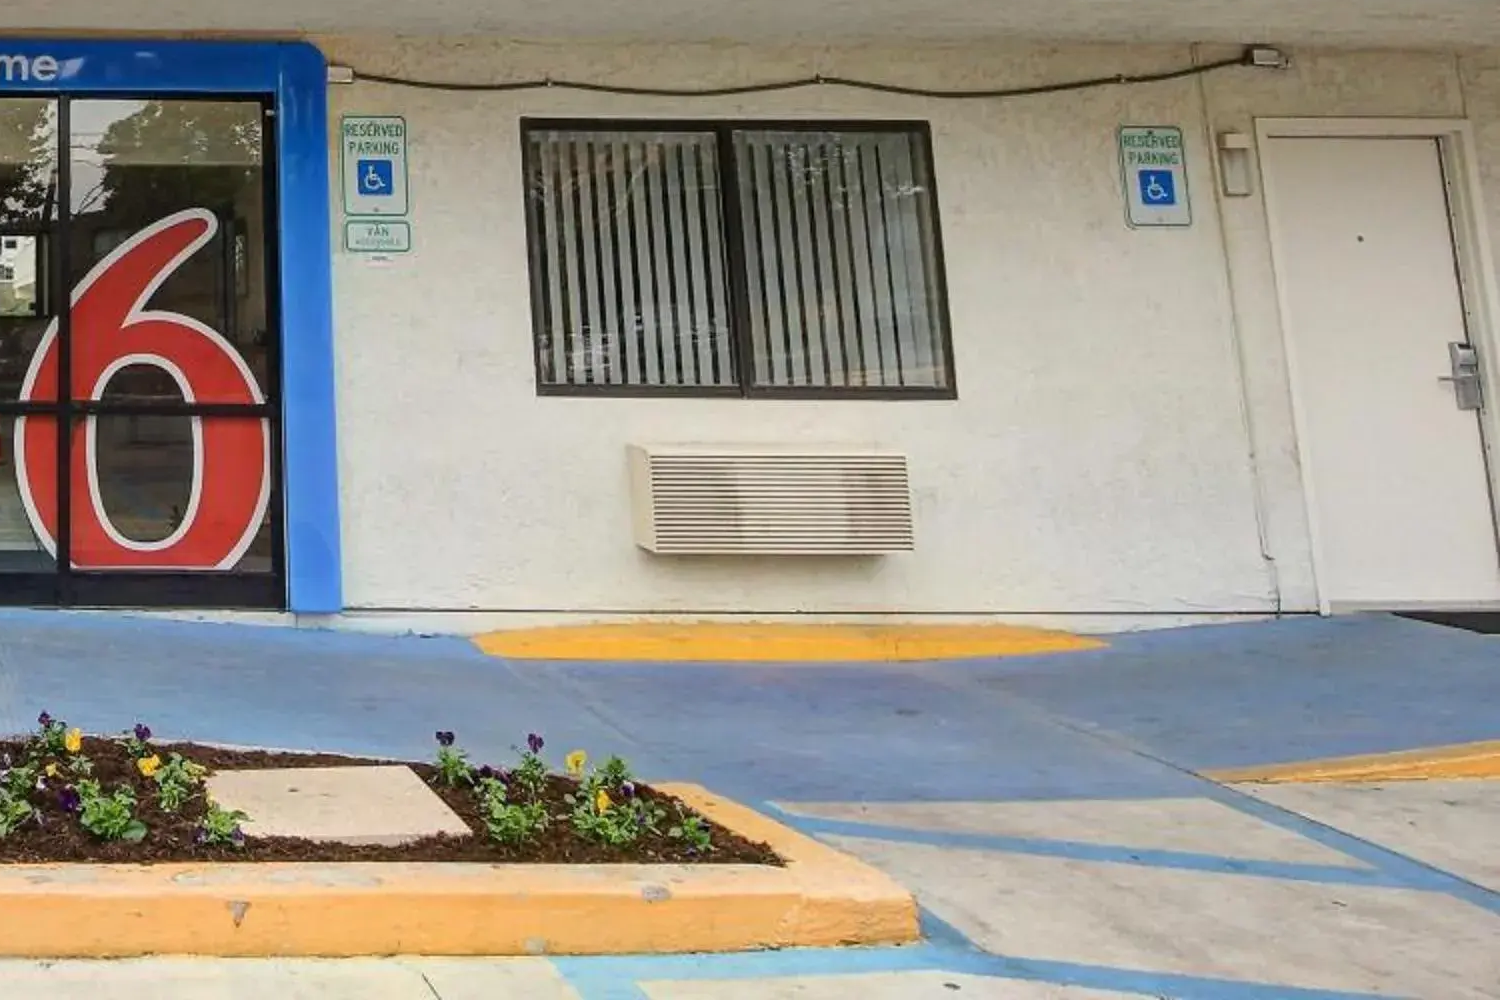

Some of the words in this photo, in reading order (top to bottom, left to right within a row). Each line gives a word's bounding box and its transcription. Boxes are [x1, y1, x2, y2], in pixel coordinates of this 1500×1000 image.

[345, 123, 403, 137] RESERVED
[349, 141, 400, 155] PARKING
[1123, 135, 1182, 148] RESERVED
[1127, 151, 1180, 165] PARKING
[14, 208, 271, 570] 6
